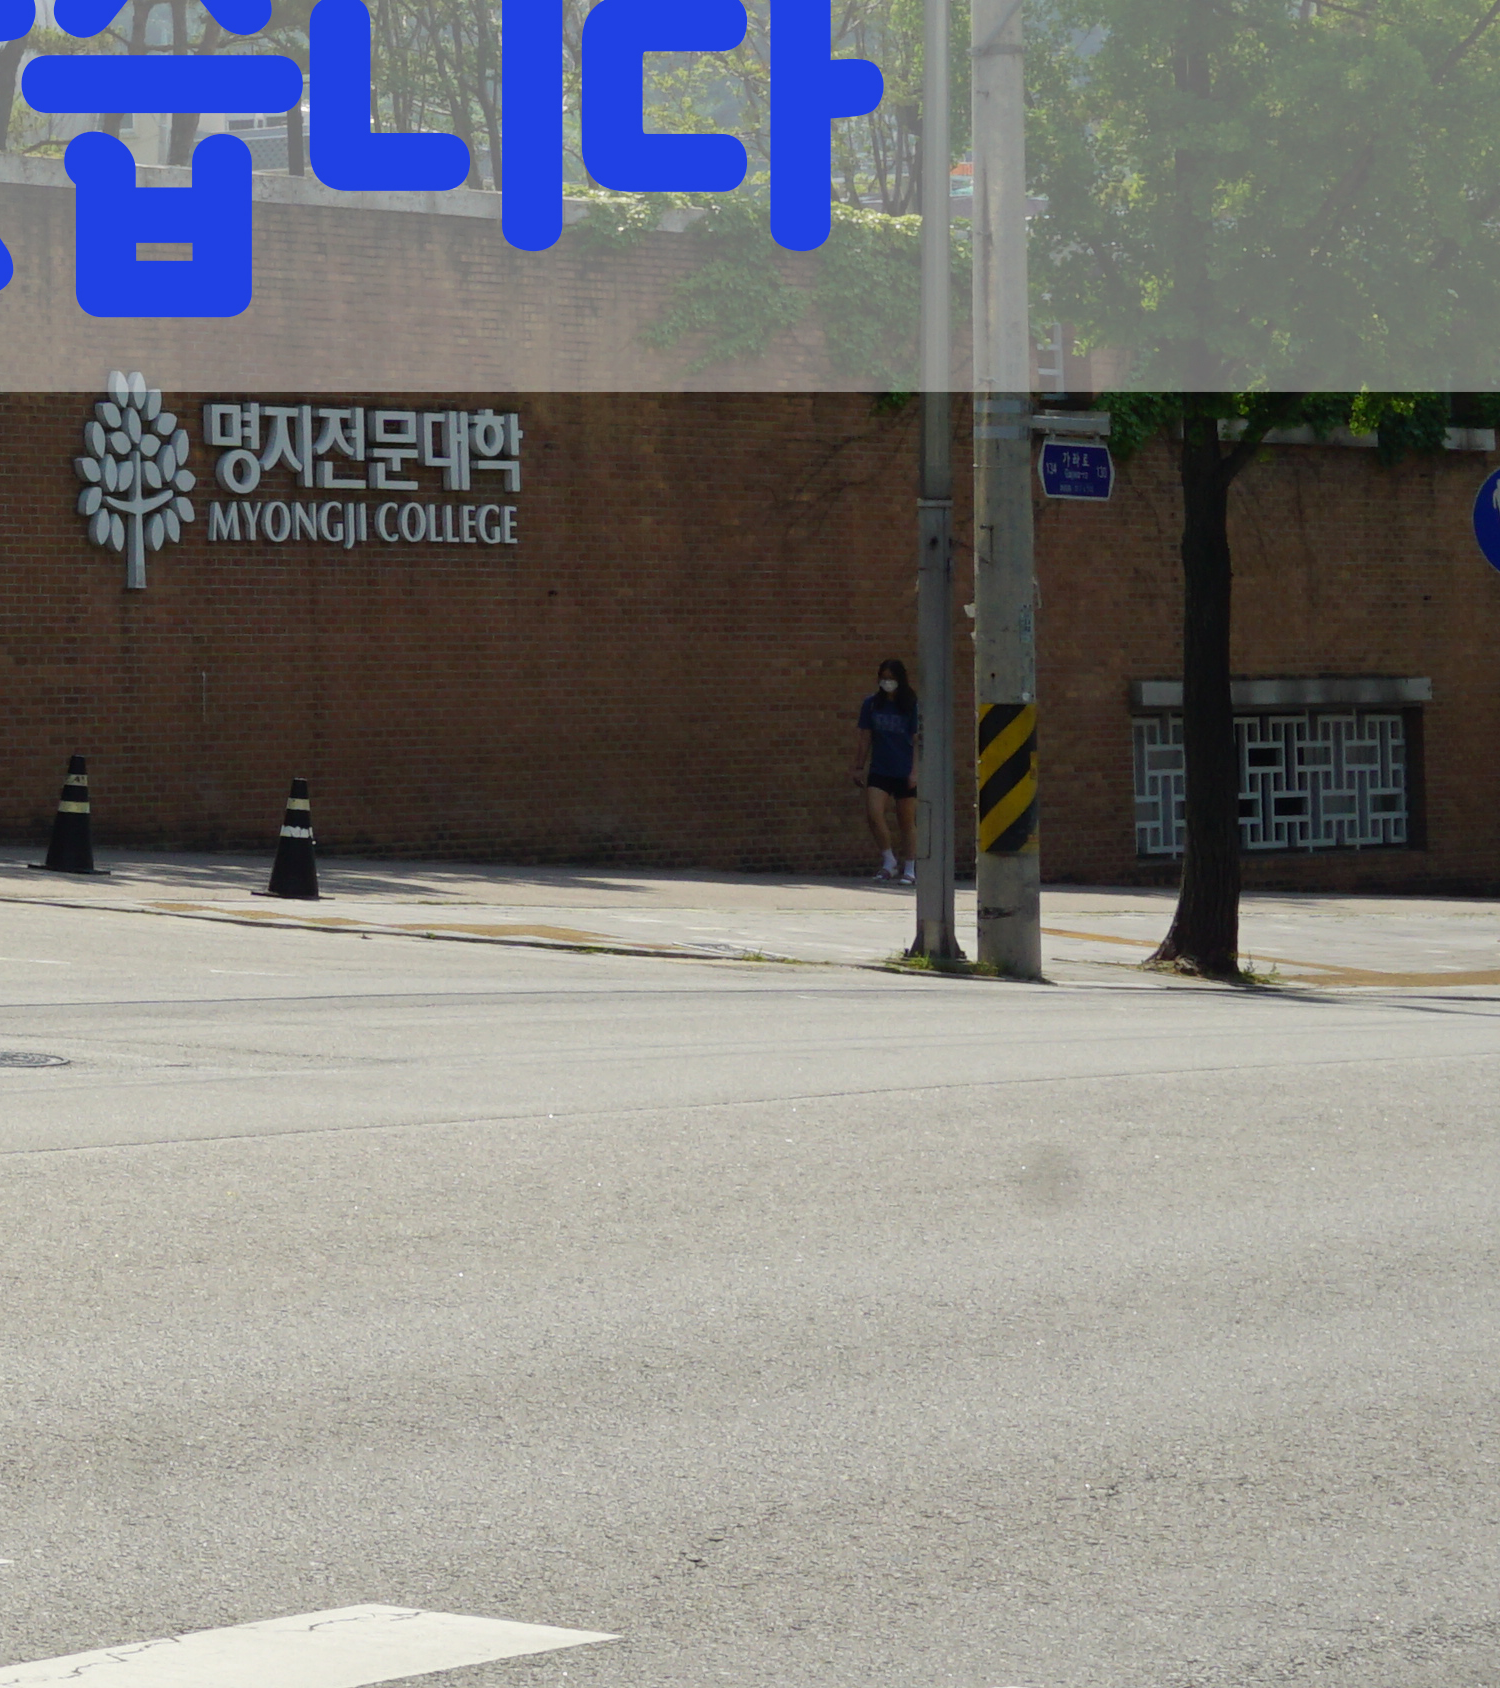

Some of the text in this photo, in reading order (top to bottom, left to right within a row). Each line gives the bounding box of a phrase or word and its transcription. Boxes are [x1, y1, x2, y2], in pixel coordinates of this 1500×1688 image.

[204, 402, 523, 494] 명지전문대학
[207, 501, 517, 549] MYONGJI COLLEGE
